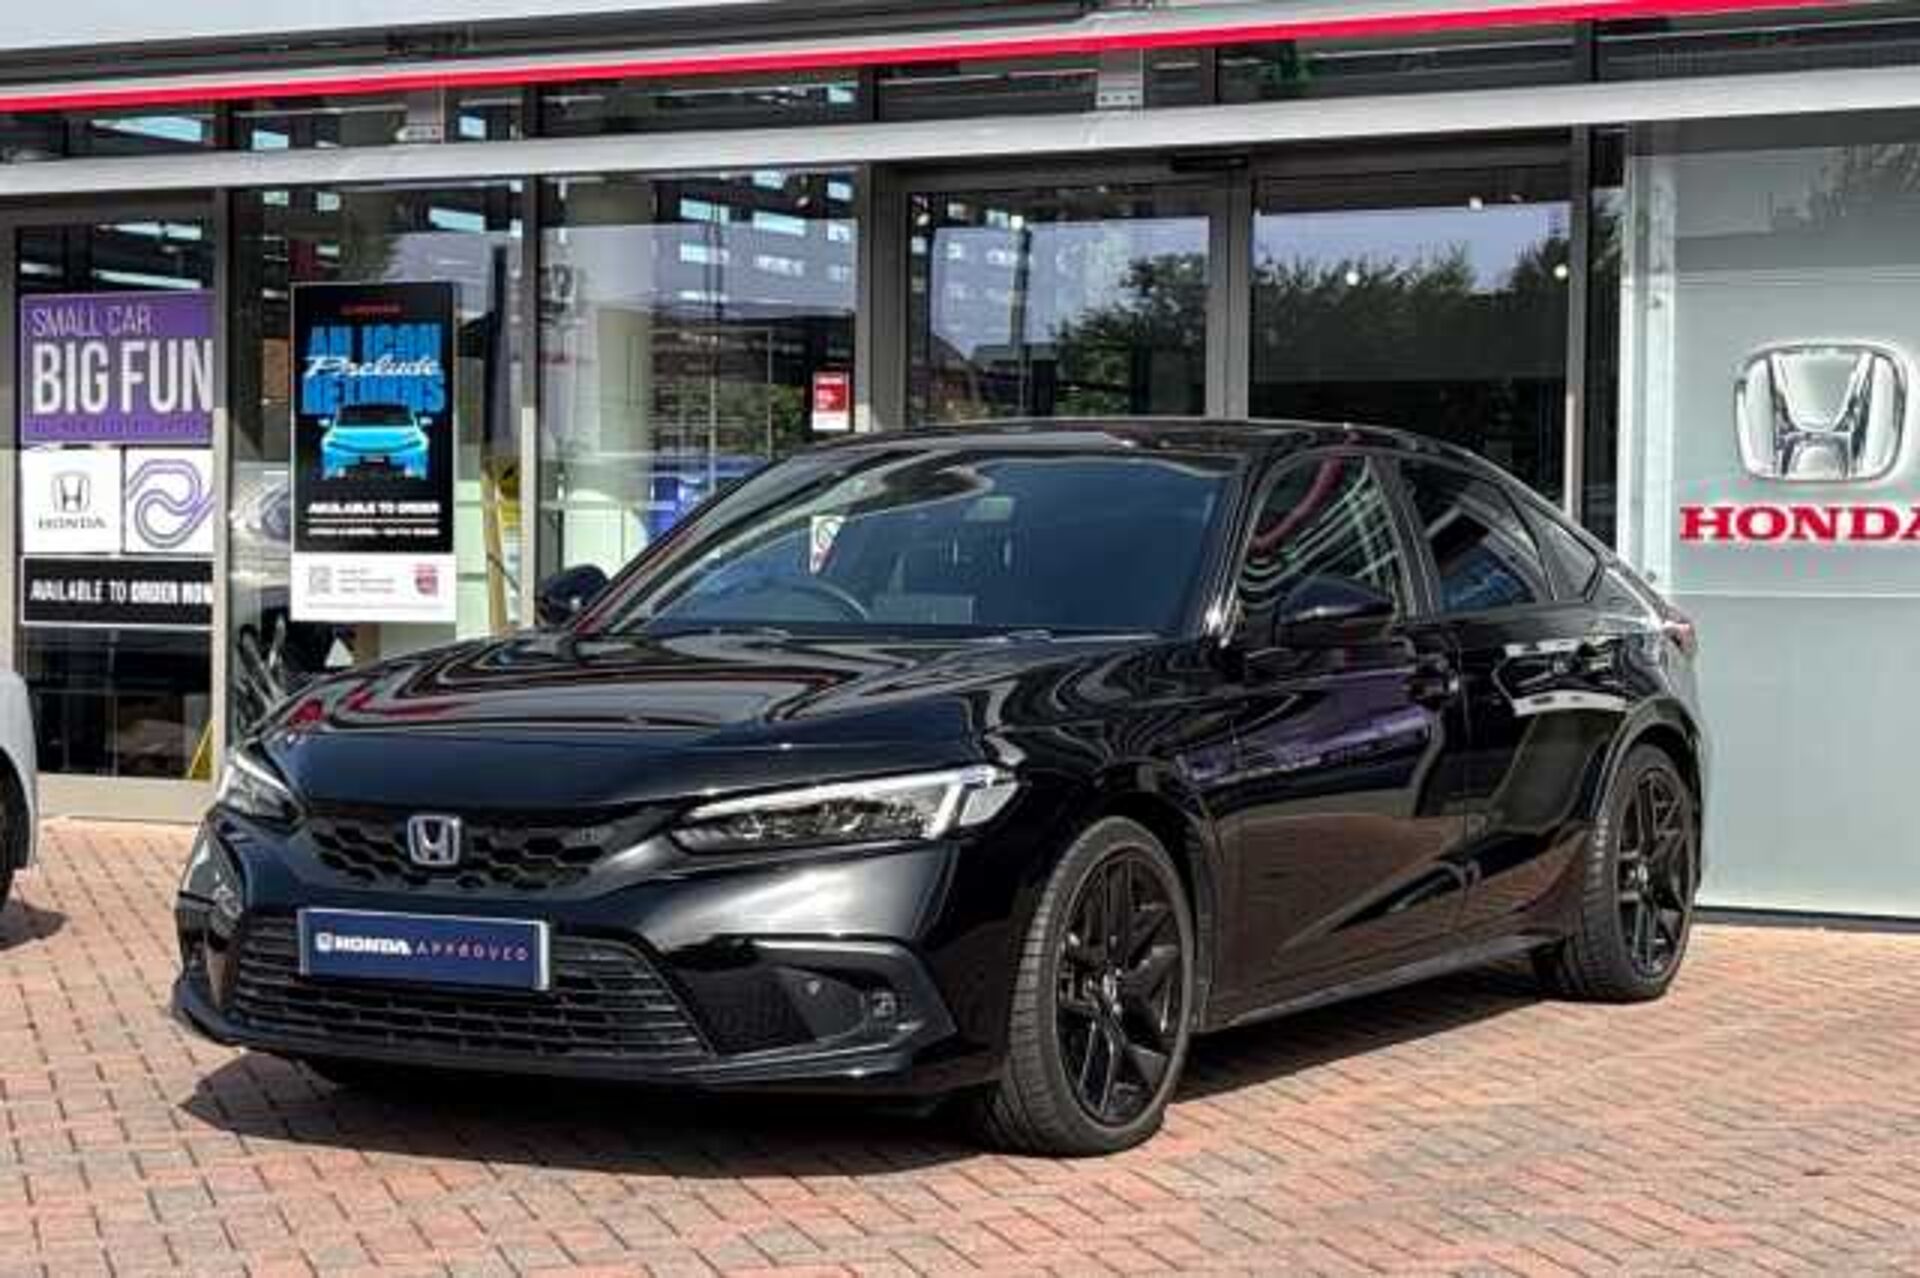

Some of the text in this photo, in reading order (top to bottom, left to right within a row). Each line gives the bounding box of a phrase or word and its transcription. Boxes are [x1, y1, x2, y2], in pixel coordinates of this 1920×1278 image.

[32, 306, 100, 337] SMALL
[32, 337, 214, 415] BIG FUN
[38, 516, 106, 530] HONDA
[30, 578, 102, 603] AVAILABLE
[110, 580, 127, 604] TO
[131, 580, 178, 604] ORDER
[335, 935, 529, 962] HONDA APPROVED
